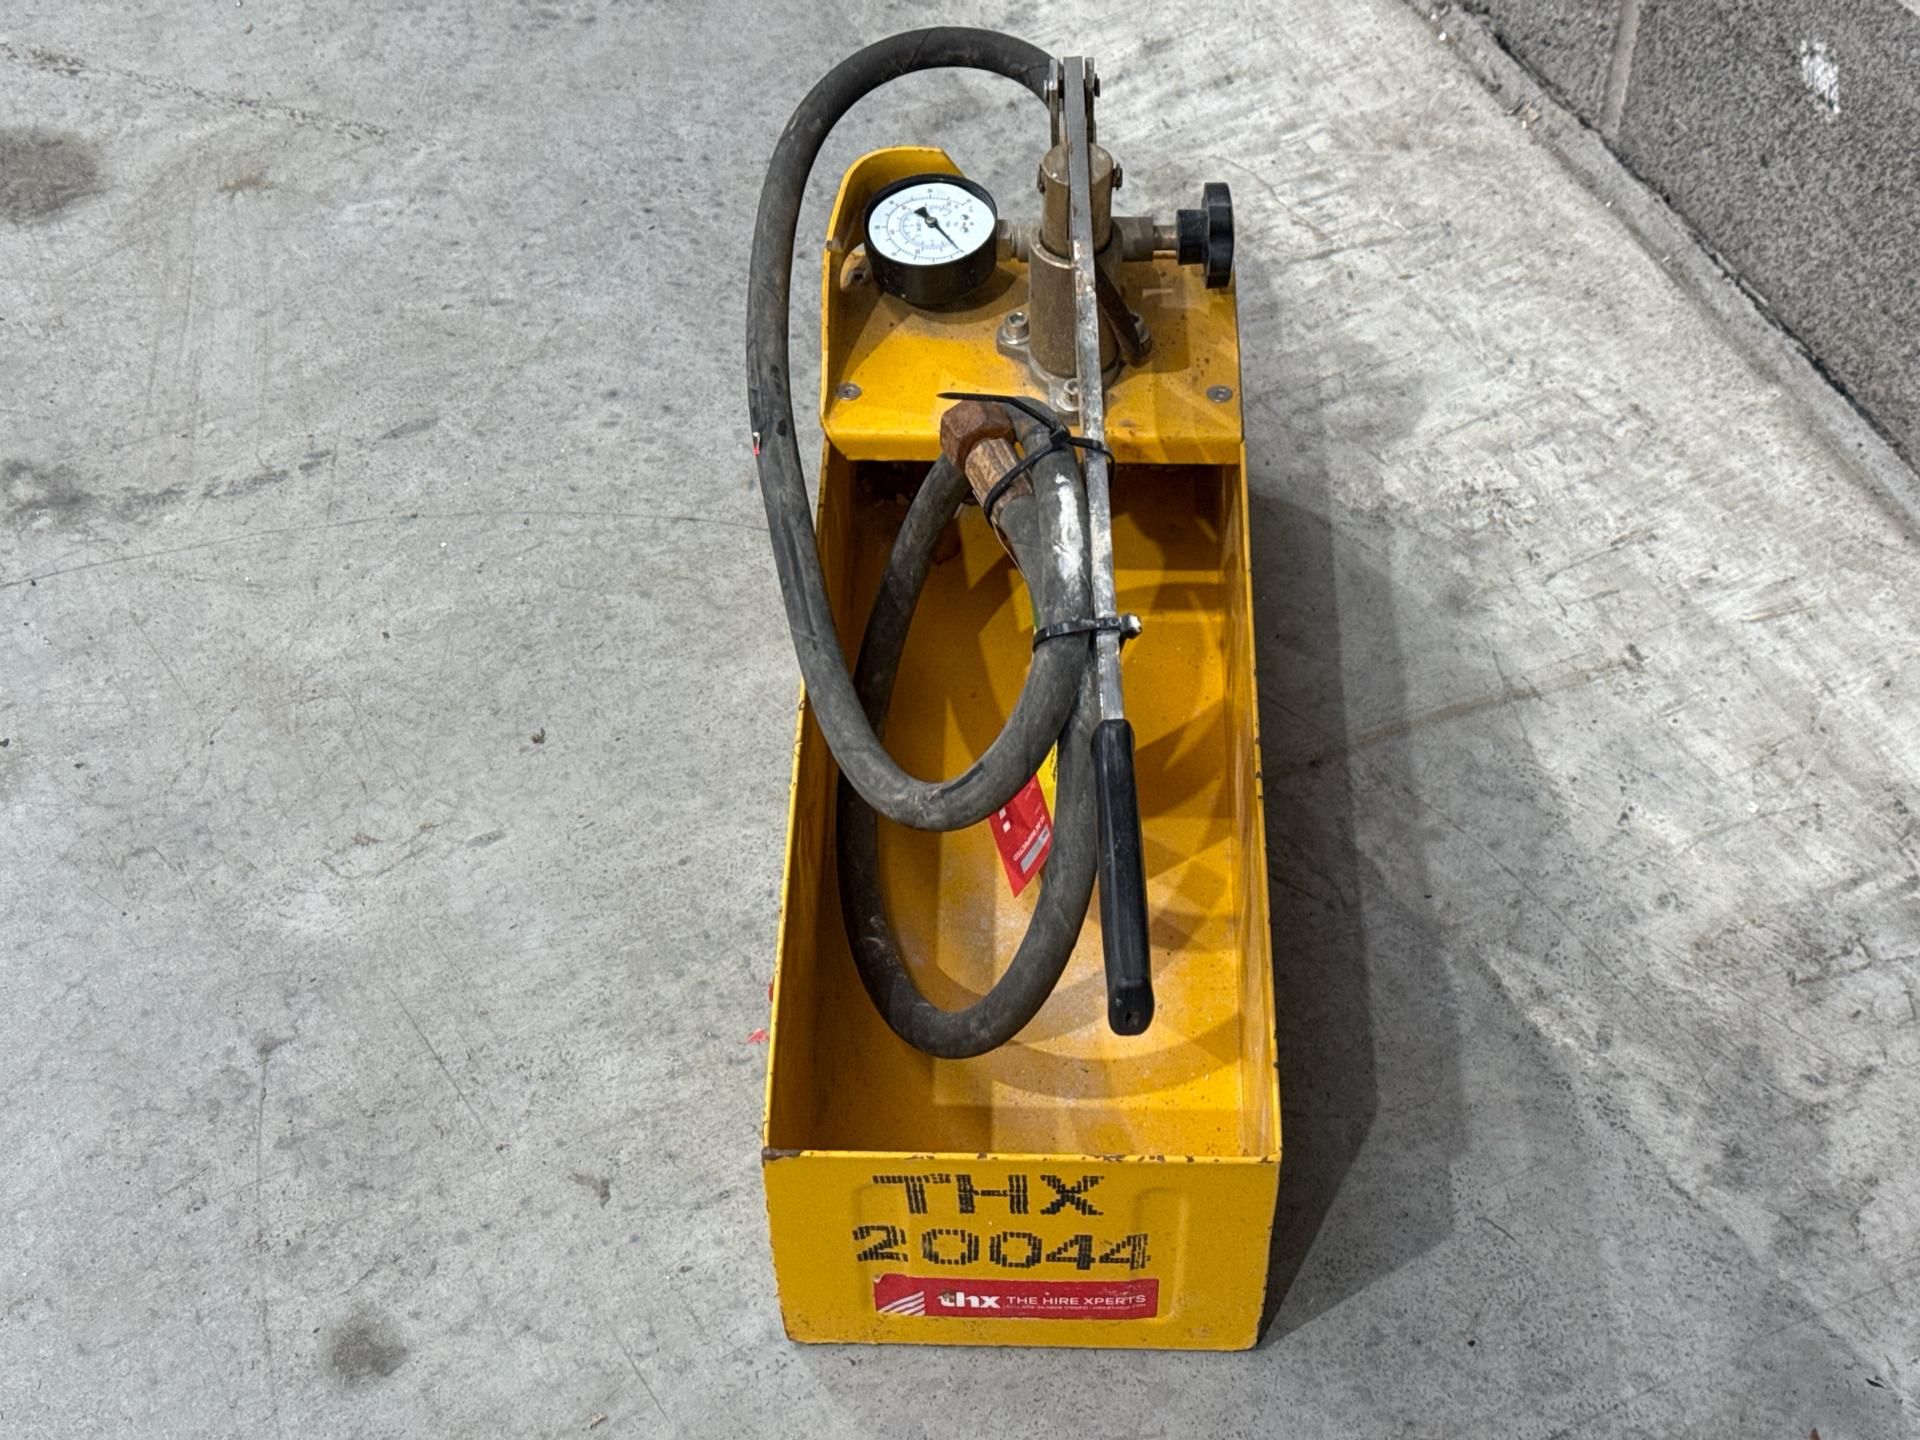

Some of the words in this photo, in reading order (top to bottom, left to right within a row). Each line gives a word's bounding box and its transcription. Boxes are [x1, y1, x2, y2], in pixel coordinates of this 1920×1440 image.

[872, 1173, 1105, 1216] THX
[852, 1225, 1151, 1270] 20044
[937, 1291, 1001, 1309] thx
[1006, 1296, 1040, 1305] THE
[1043, 1296, 1080, 1306] HIRE
[1083, 1294, 1146, 1306] XPERTS
